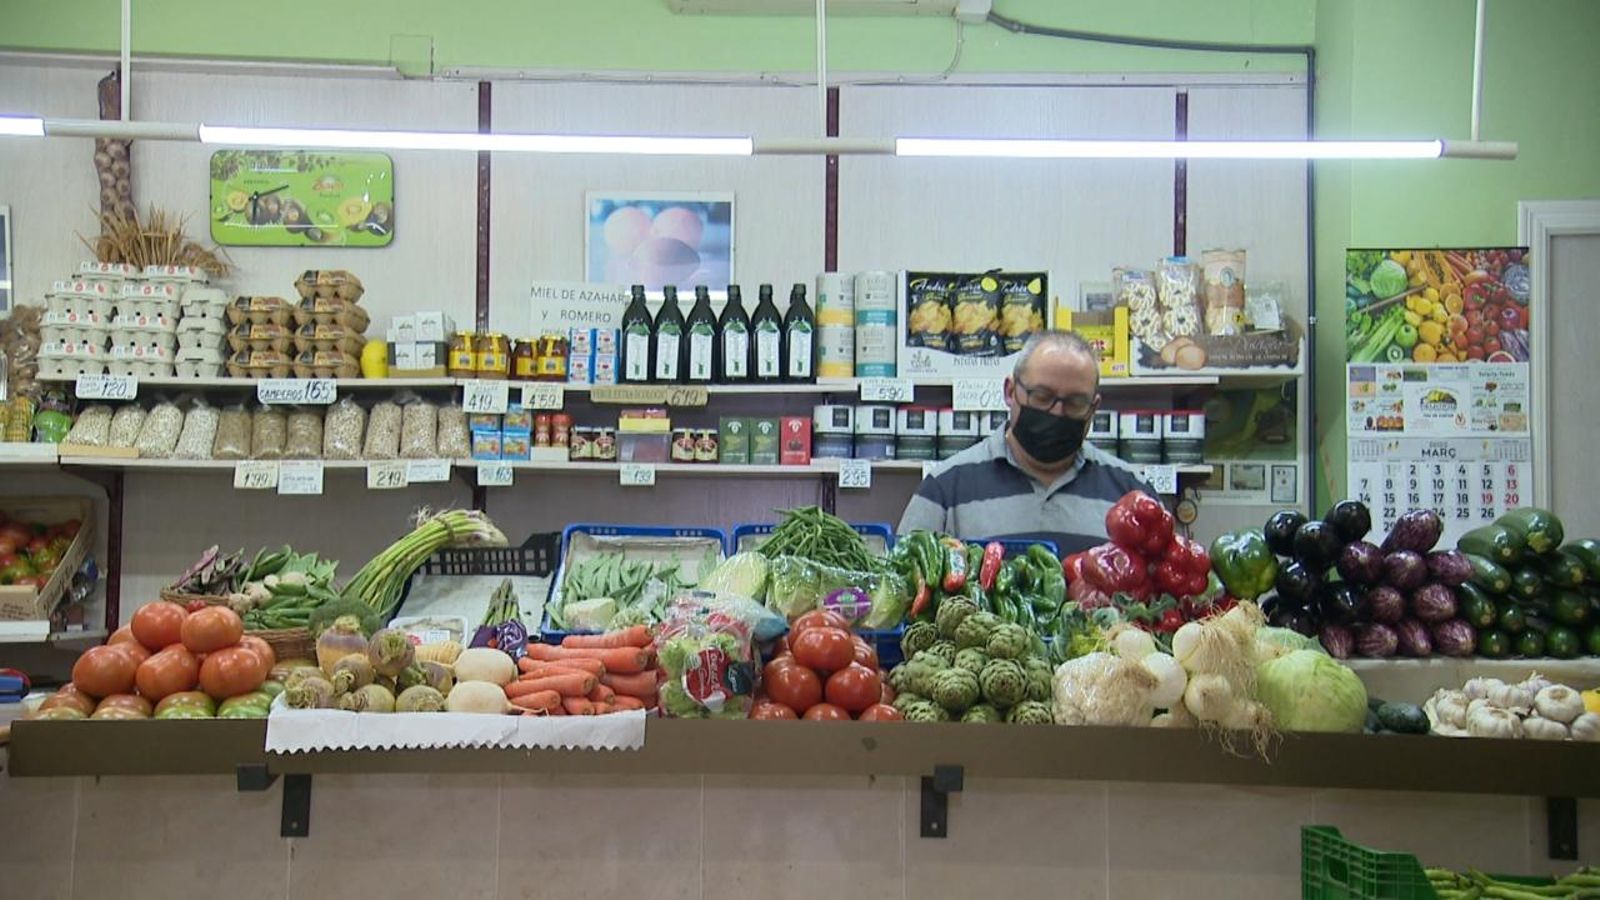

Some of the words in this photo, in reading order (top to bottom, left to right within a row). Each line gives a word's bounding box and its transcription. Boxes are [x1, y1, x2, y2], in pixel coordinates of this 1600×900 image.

[530, 287, 558, 300] MIEL
[562, 289, 576, 301] DE
[580, 290, 624, 305] AZAHAR
[560, 309, 612, 324] ROMERO
[1421, 448, 1456, 459] MARÇ
[1386, 464, 1392, 475] 1
[1410, 464, 1416, 475] 2
[1434, 465, 1441, 475] 3
[1458, 465, 1465, 475] 4
[1484, 465, 1490, 475] 5
[1508, 465, 1515, 475] 6
[1361, 479, 1368, 489] 7
[1386, 479, 1393, 490] 8
[1410, 479, 1417, 490] 9
[1432, 479, 1444, 490] 10
[1458, 479, 1466, 490] 11
[1482, 479, 1493, 490] 12
[1507, 479, 1518, 490] 13
[1360, 493, 1371, 503] 14
[1384, 493, 1395, 504] 15
[1408, 493, 1419, 504] 16
[1433, 493, 1444, 504] 17
[1456, 493, 1468, 505] 18
[1482, 493, 1493, 505] 19
[1505, 494, 1519, 505] 20
[1384, 507, 1396, 518] 22
[1456, 508, 1470, 519] 25
[1481, 508, 1495, 519] 26
